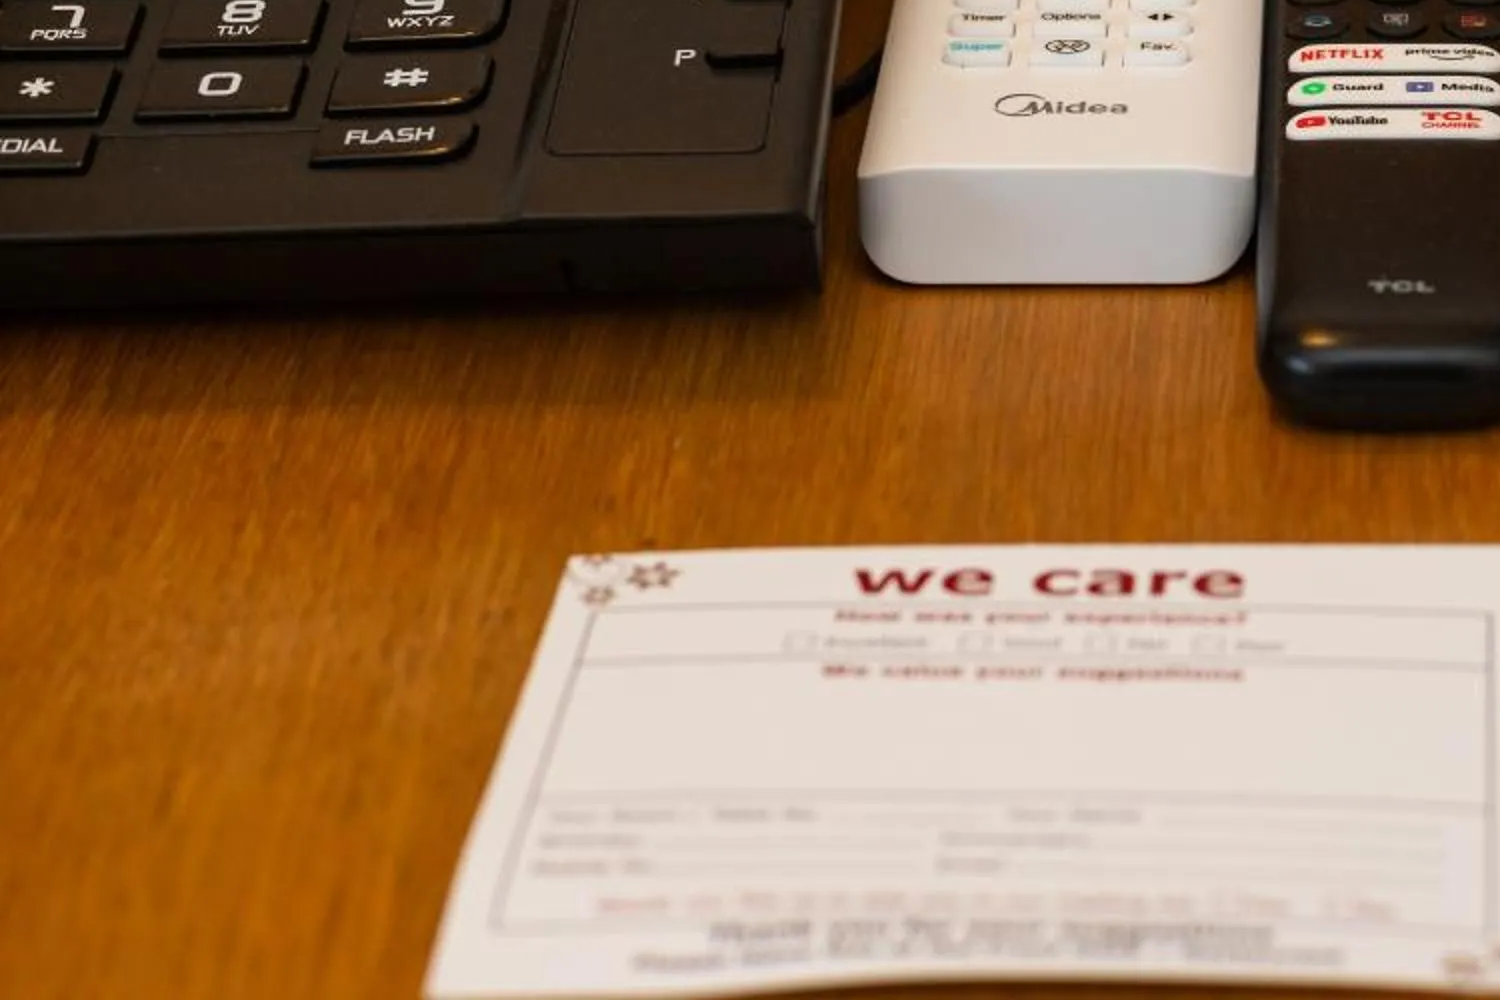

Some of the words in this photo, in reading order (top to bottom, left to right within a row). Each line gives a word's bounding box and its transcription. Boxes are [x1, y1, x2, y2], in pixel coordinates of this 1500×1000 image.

[51, 5, 86, 28] 7
[221, 0, 267, 23] 8
[1041, 12, 1102, 22] Options
[387, 16, 455, 28] WXYZ
[30, 28, 88, 40] PQRS
[217, 24, 260, 36] TUV
[673, 49, 697, 67] P
[1300, 48, 1384, 62] NETFLIX
[1405, 48, 1449, 57] prime
[1454, 47, 1495, 58] video
[1332, 82, 1384, 92] Guard
[1441, 83, 1495, 93] Media
[997, 96, 1129, 116] Midea
[1328, 115, 1389, 126] YouTube
[1421, 111, 1482, 121] TCL
[1421, 121, 1481, 130] CHANNEL
[344, 126, 436, 145] FLASH
[0, 138, 64, 153] DIAL
[1367, 279, 1436, 294] TCL
[854, 567, 995, 598] we
[1032, 567, 1246, 599] care
